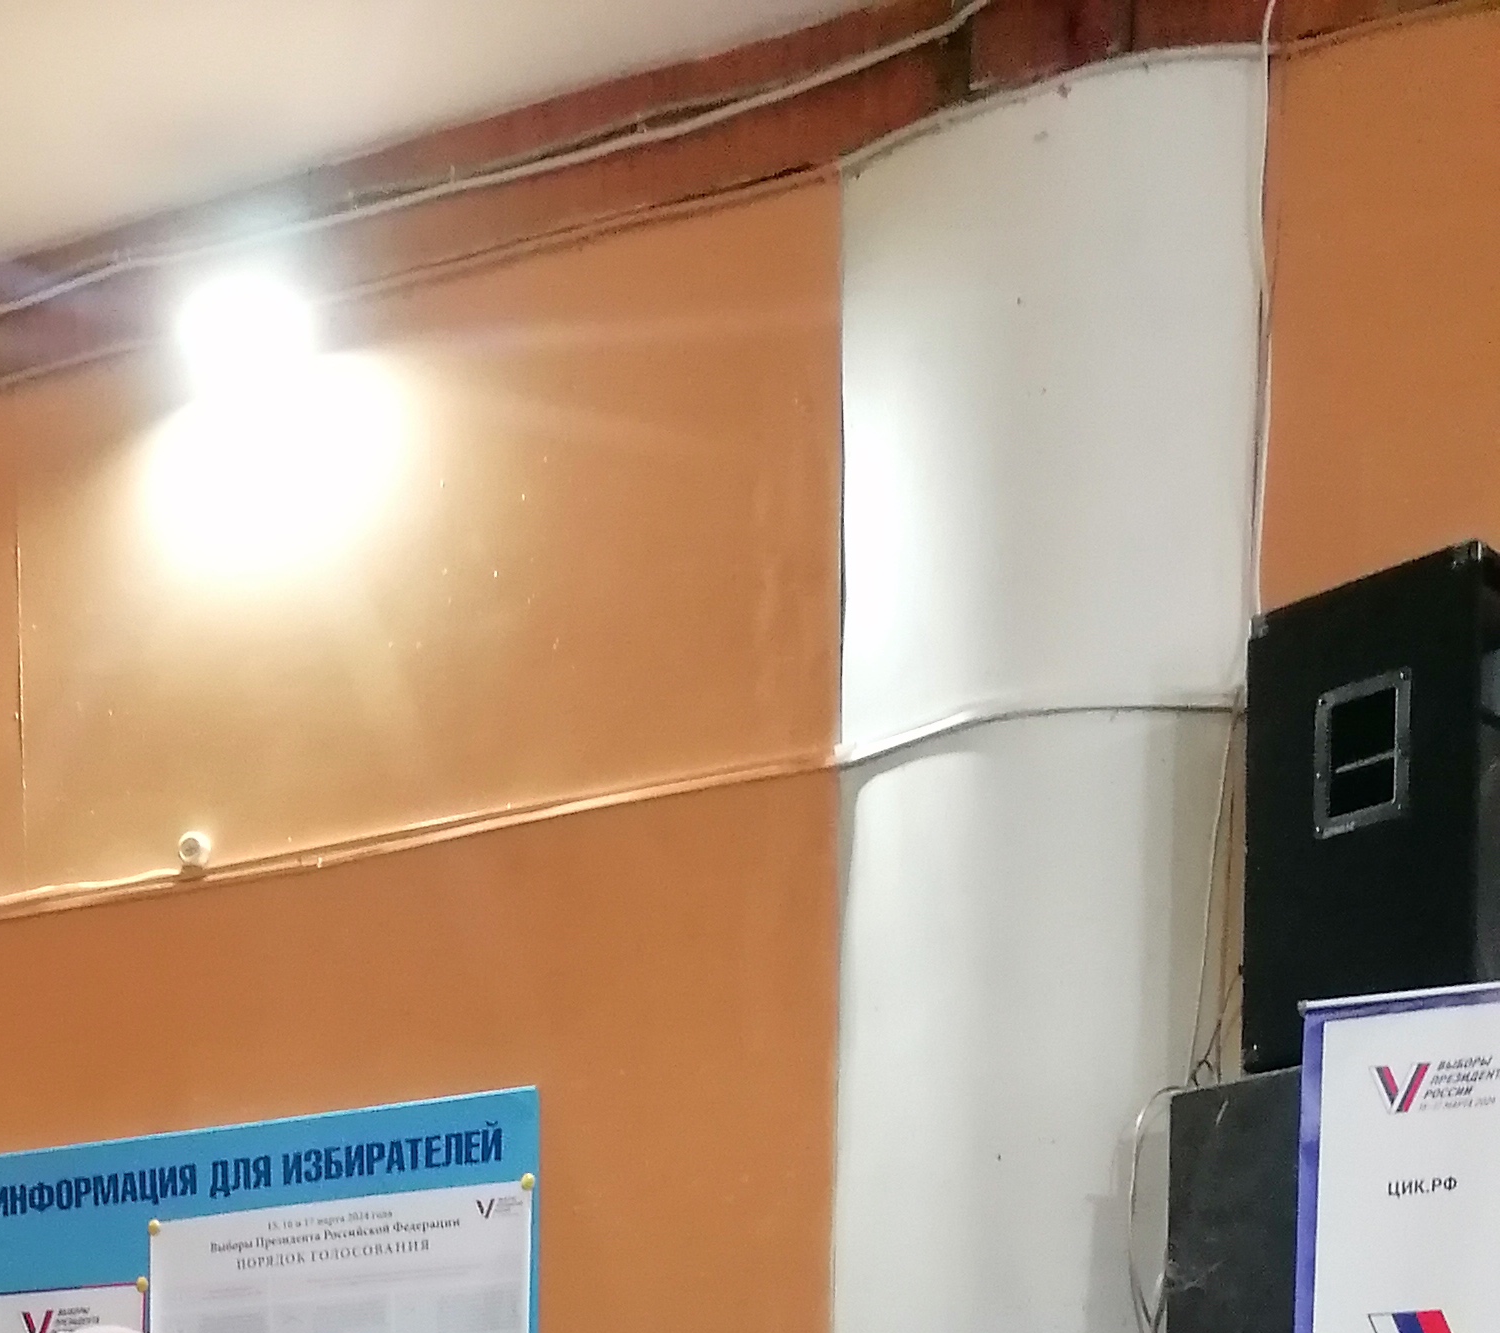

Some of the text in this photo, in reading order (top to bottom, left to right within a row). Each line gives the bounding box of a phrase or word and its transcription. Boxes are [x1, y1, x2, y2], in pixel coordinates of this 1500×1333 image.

[1437, 1055, 1493, 1071] ВЫБОРЫ
[1430, 1069, 1500, 1085] ПРЕЗИДЕНТ
[1424, 1085, 1474, 1099] РОССИИ
[209, 1156, 272, 1197] ДЛЯ
[282, 1120, 505, 1185] ИЗБИРАТЕЛЕЙ
[1387, 1176, 1458, 1199] ЦИК.РФ
[210, 1217, 461, 1255] Выборы Президента Российской Федерации
[236, 1239, 431, 1270] ПОРЯДОК ГОЛОСОВАНИЯ
